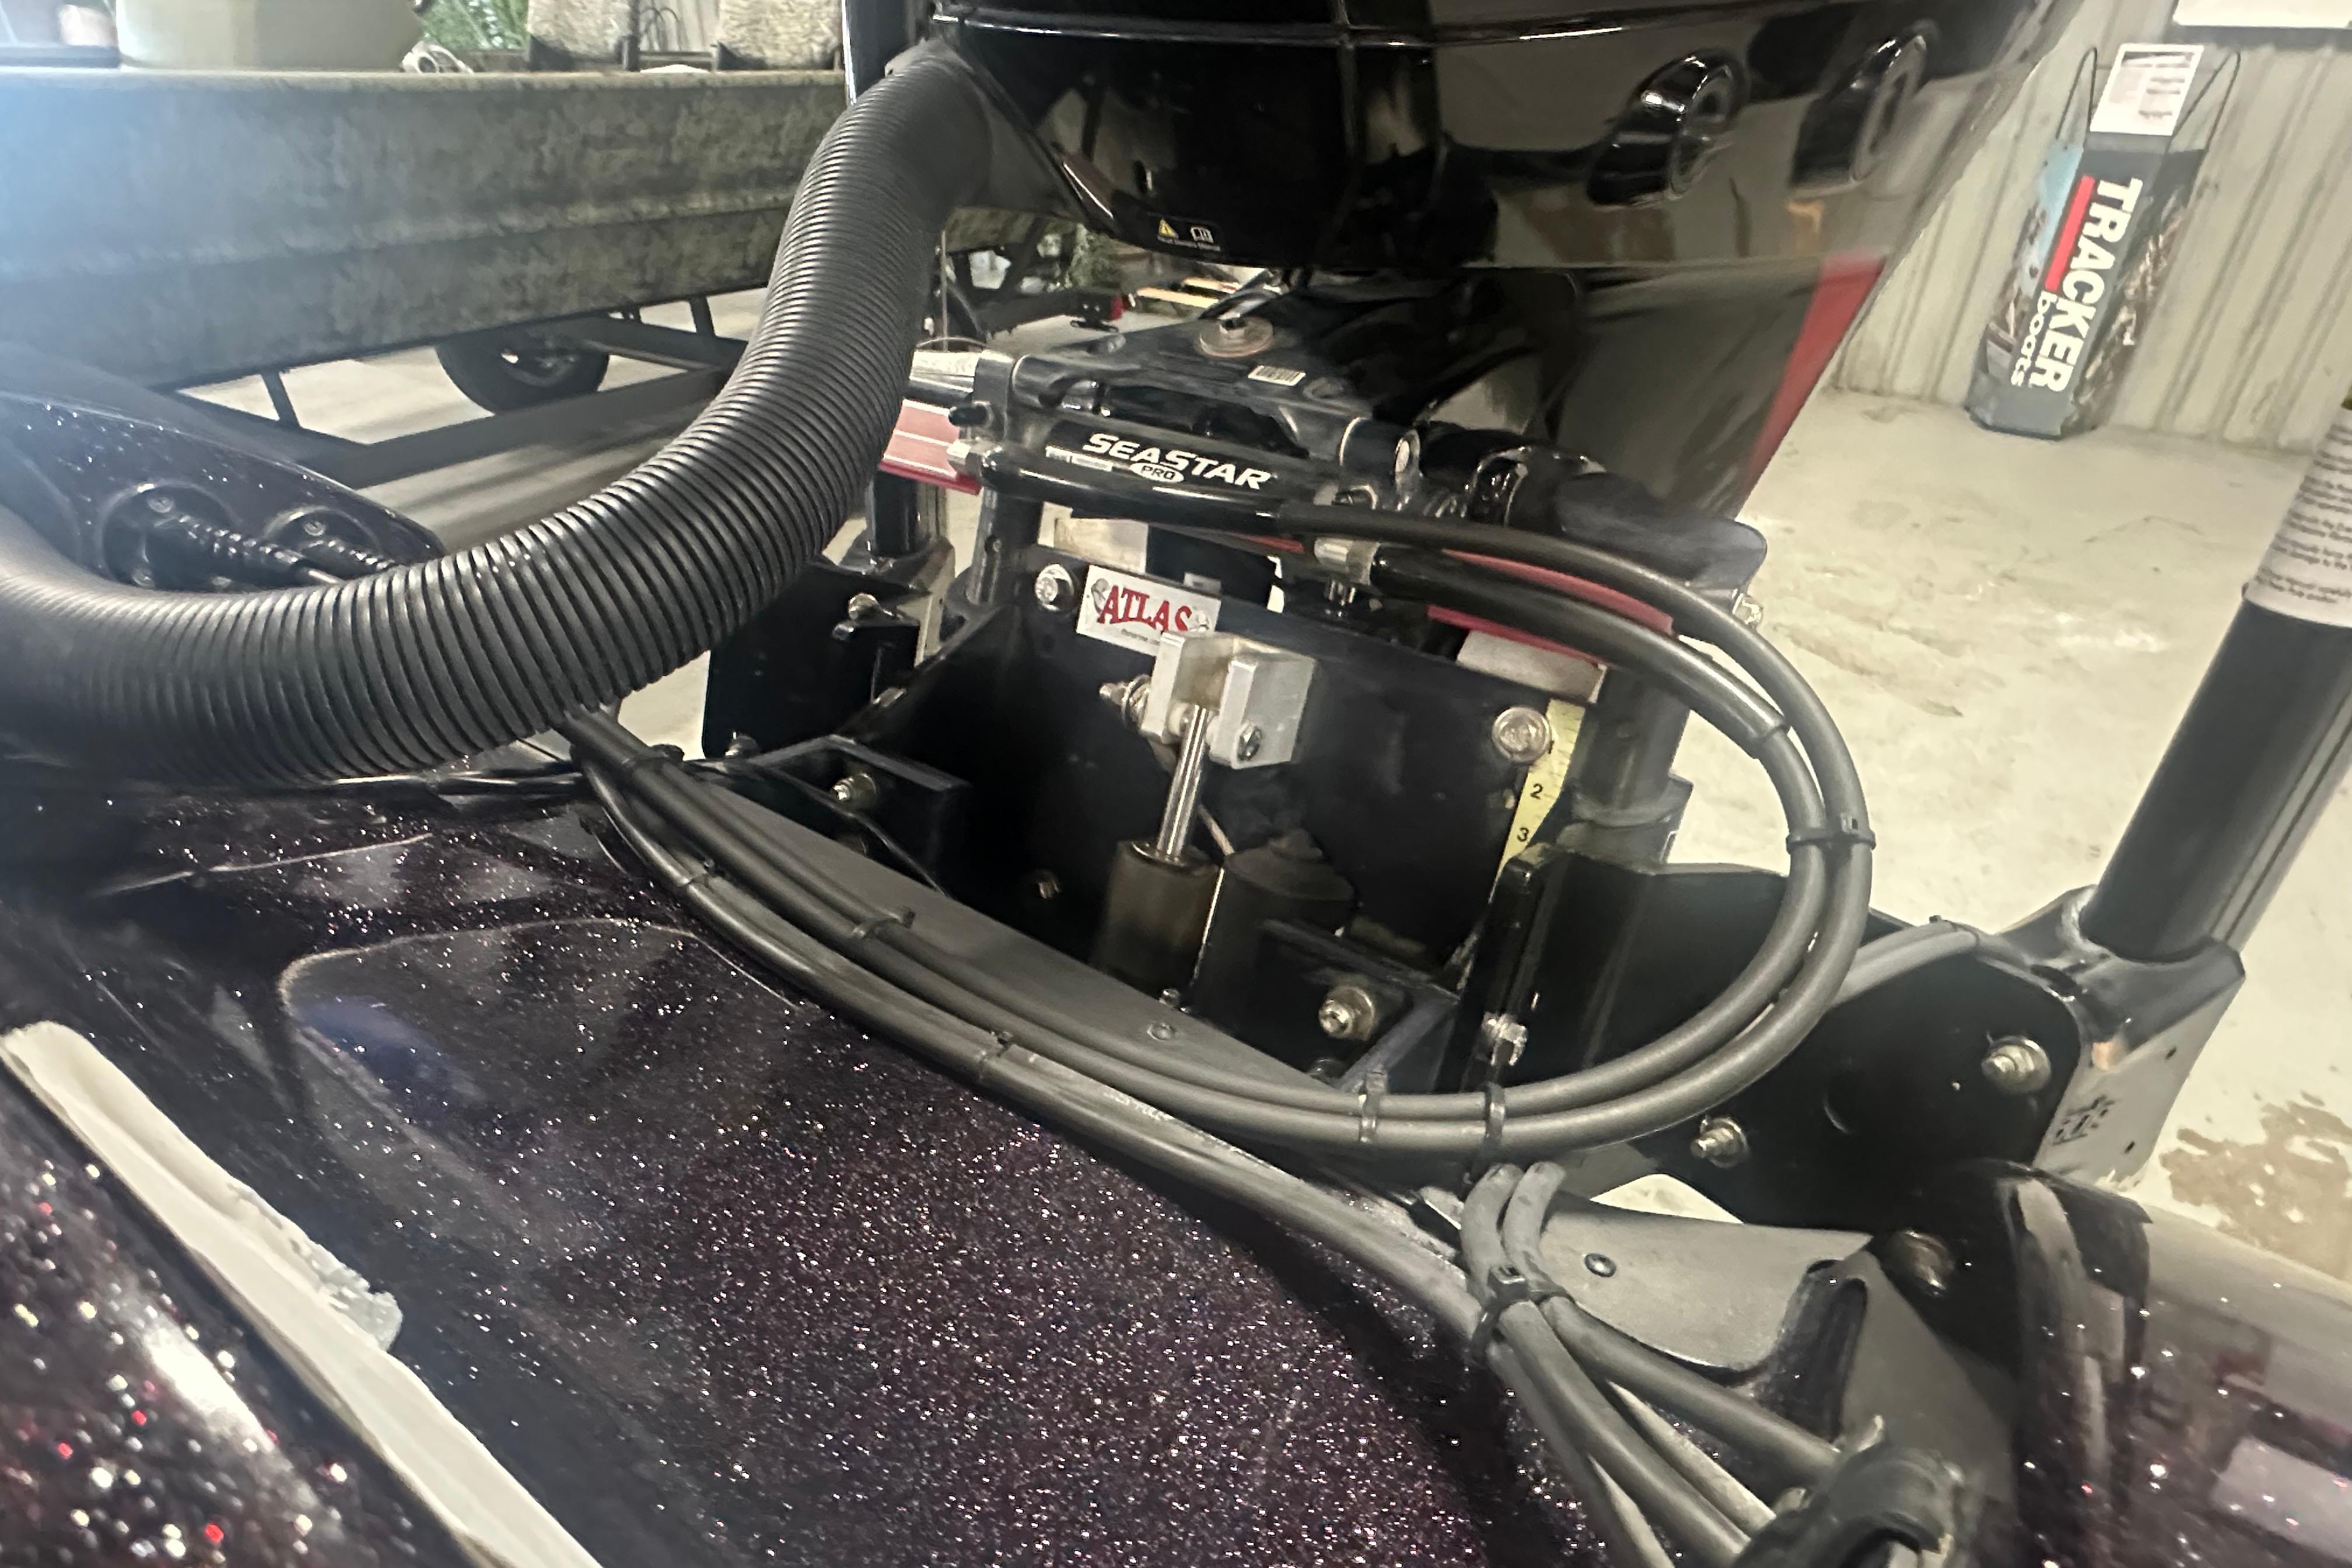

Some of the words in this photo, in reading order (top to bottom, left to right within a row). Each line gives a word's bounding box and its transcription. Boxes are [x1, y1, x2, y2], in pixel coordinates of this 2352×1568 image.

[2029, 178, 2143, 392] TRACKER
[2011, 291, 2057, 387] boats
[1083, 433, 1271, 490] SEASTAR
[1140, 466, 1175, 480] PRO
[1097, 585, 1192, 632] ATLAS
[1530, 783, 1544, 799] 2
[1517, 827, 1529, 842] 3
